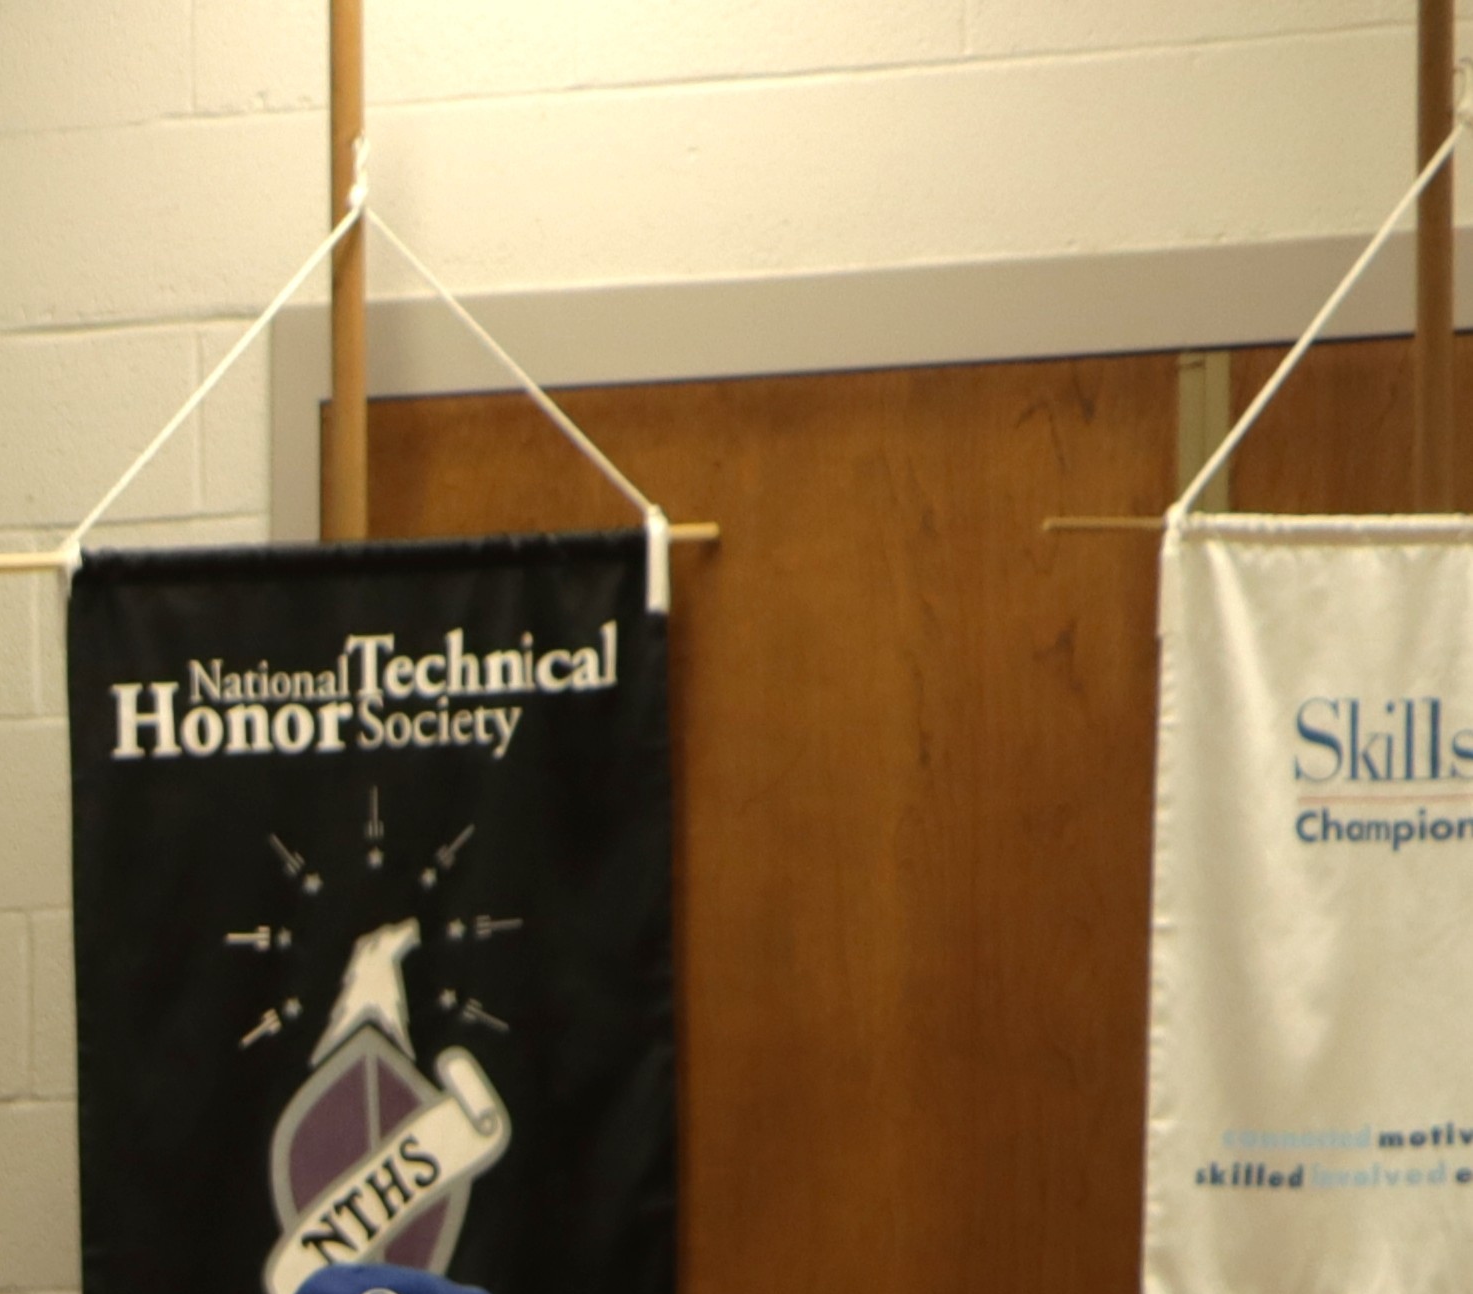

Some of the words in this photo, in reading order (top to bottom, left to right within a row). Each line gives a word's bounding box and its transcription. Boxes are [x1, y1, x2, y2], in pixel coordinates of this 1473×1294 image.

[188, 653, 350, 702] National
[346, 619, 618, 700] Technical
[110, 681, 353, 759] Honor
[357, 695, 524, 759] Society
[300, 1133, 442, 1267] NTHS
[1195, 1161, 1304, 1188] skilled
